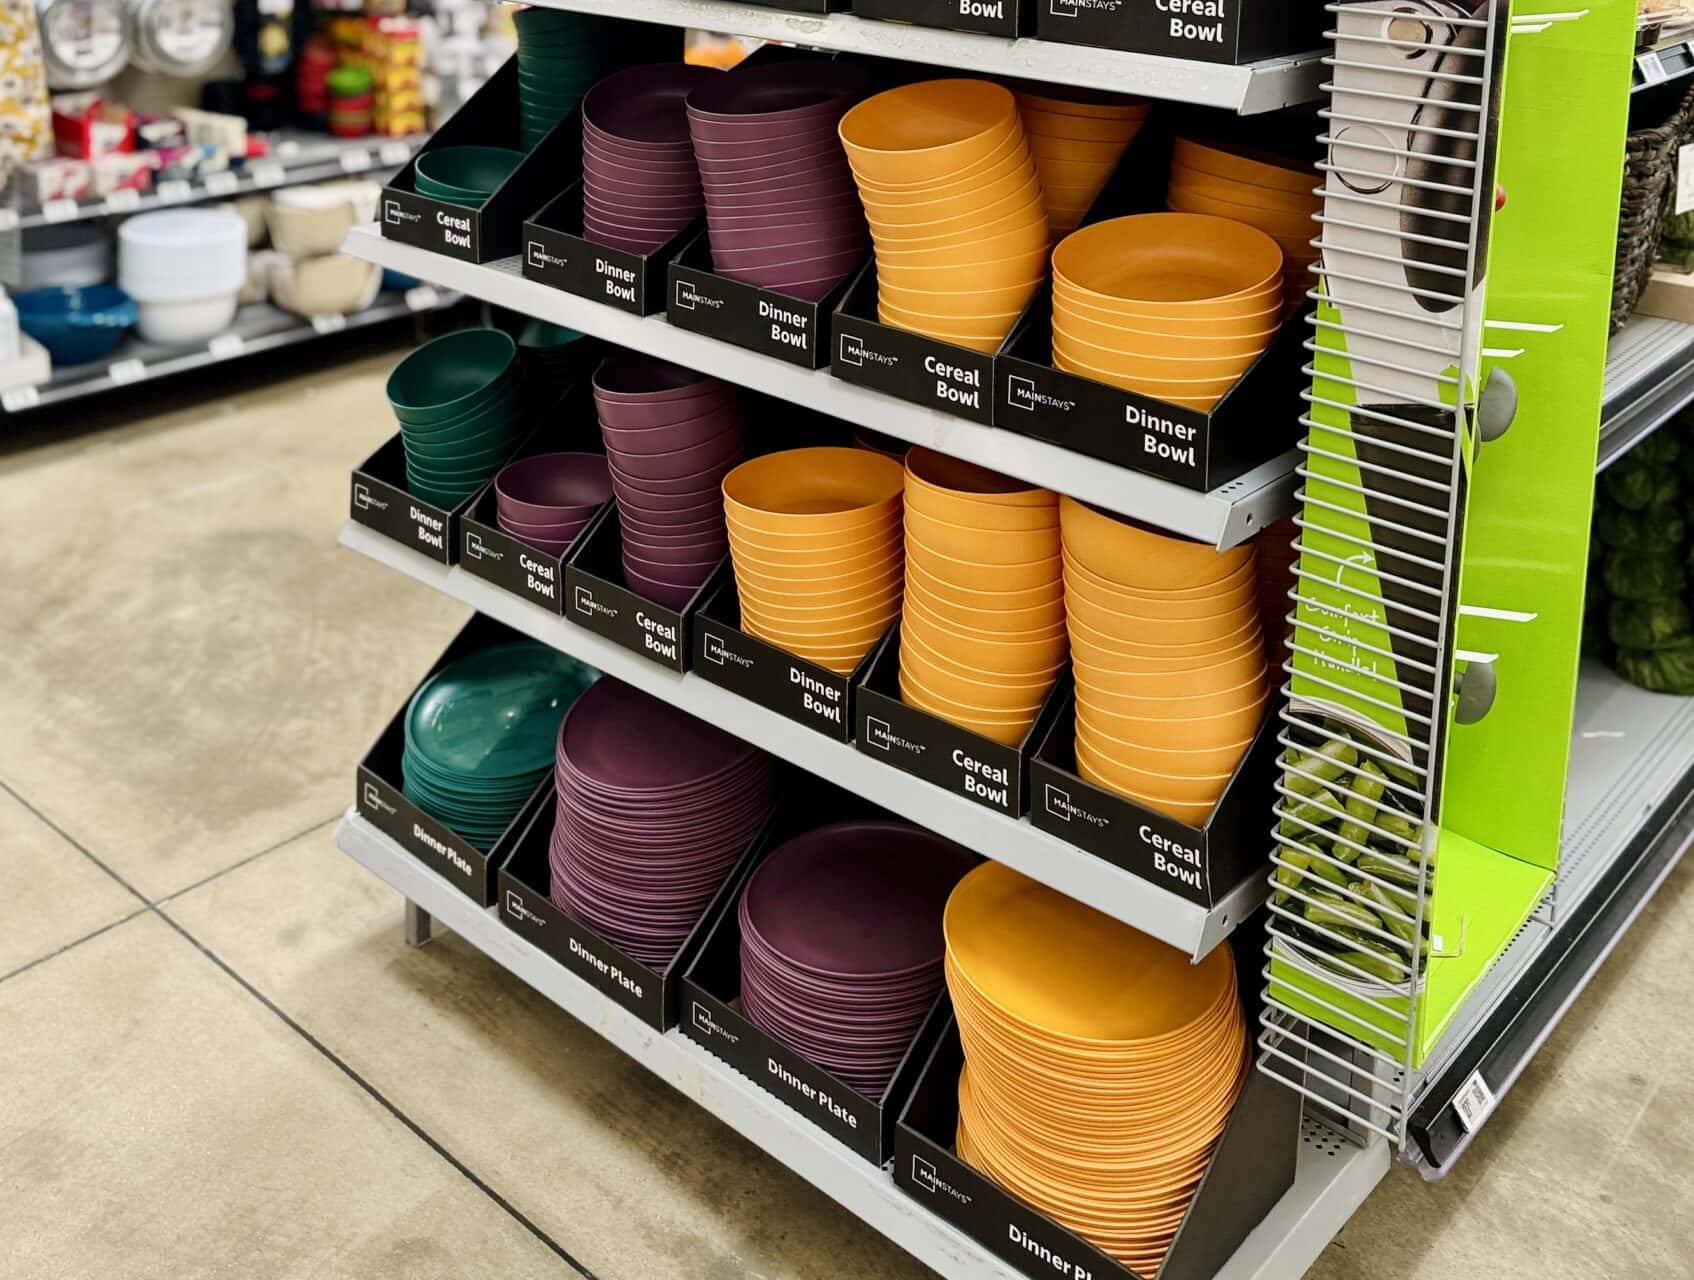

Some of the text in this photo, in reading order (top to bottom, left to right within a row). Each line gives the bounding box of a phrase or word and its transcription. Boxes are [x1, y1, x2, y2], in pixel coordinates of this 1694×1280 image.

[1169, 18, 1224, 43] Bowl
[436, 210, 470, 232] Cereal
[445, 229, 471, 249] Bowl
[595, 258, 636, 283] Dinner
[606, 280, 636, 303] Bowl
[759, 301, 807, 329] Dinner
[771, 324, 807, 350] Bowl
[924, 355, 980, 387] Cereal
[936, 380, 980, 409] Bowl
[1017, 388, 1071, 411] MAINSTAYS
[1125, 405, 1197, 441] Dinner
[1143, 434, 1197, 467] Bowl
[410, 506, 443, 533] Dinner
[418, 526, 443, 550] Bowl
[519, 553, 555, 582] Cereal
[527, 574, 555, 600] Bowl
[635, 611, 677, 643] Cereal
[645, 633, 677, 661] Bowl
[790, 667, 841, 702] Dinner
[803, 692, 841, 724] Bowl
[952, 749, 1009, 786] Cereal
[965, 774, 1009, 807] Bowl
[1053, 796, 1105, 828] MAINSTAYS
[413, 823, 472, 877] Dinner Plate
[1139, 825, 1202, 868] Cereal
[1154, 852, 1202, 890] Bowl
[569, 937, 643, 999] Dinner Plate
[768, 1057, 858, 1129] Dinner Plate
[920, 1168, 969, 1204] MAINSTAYS
[1008, 1223, 1072, 1275] Dinner
